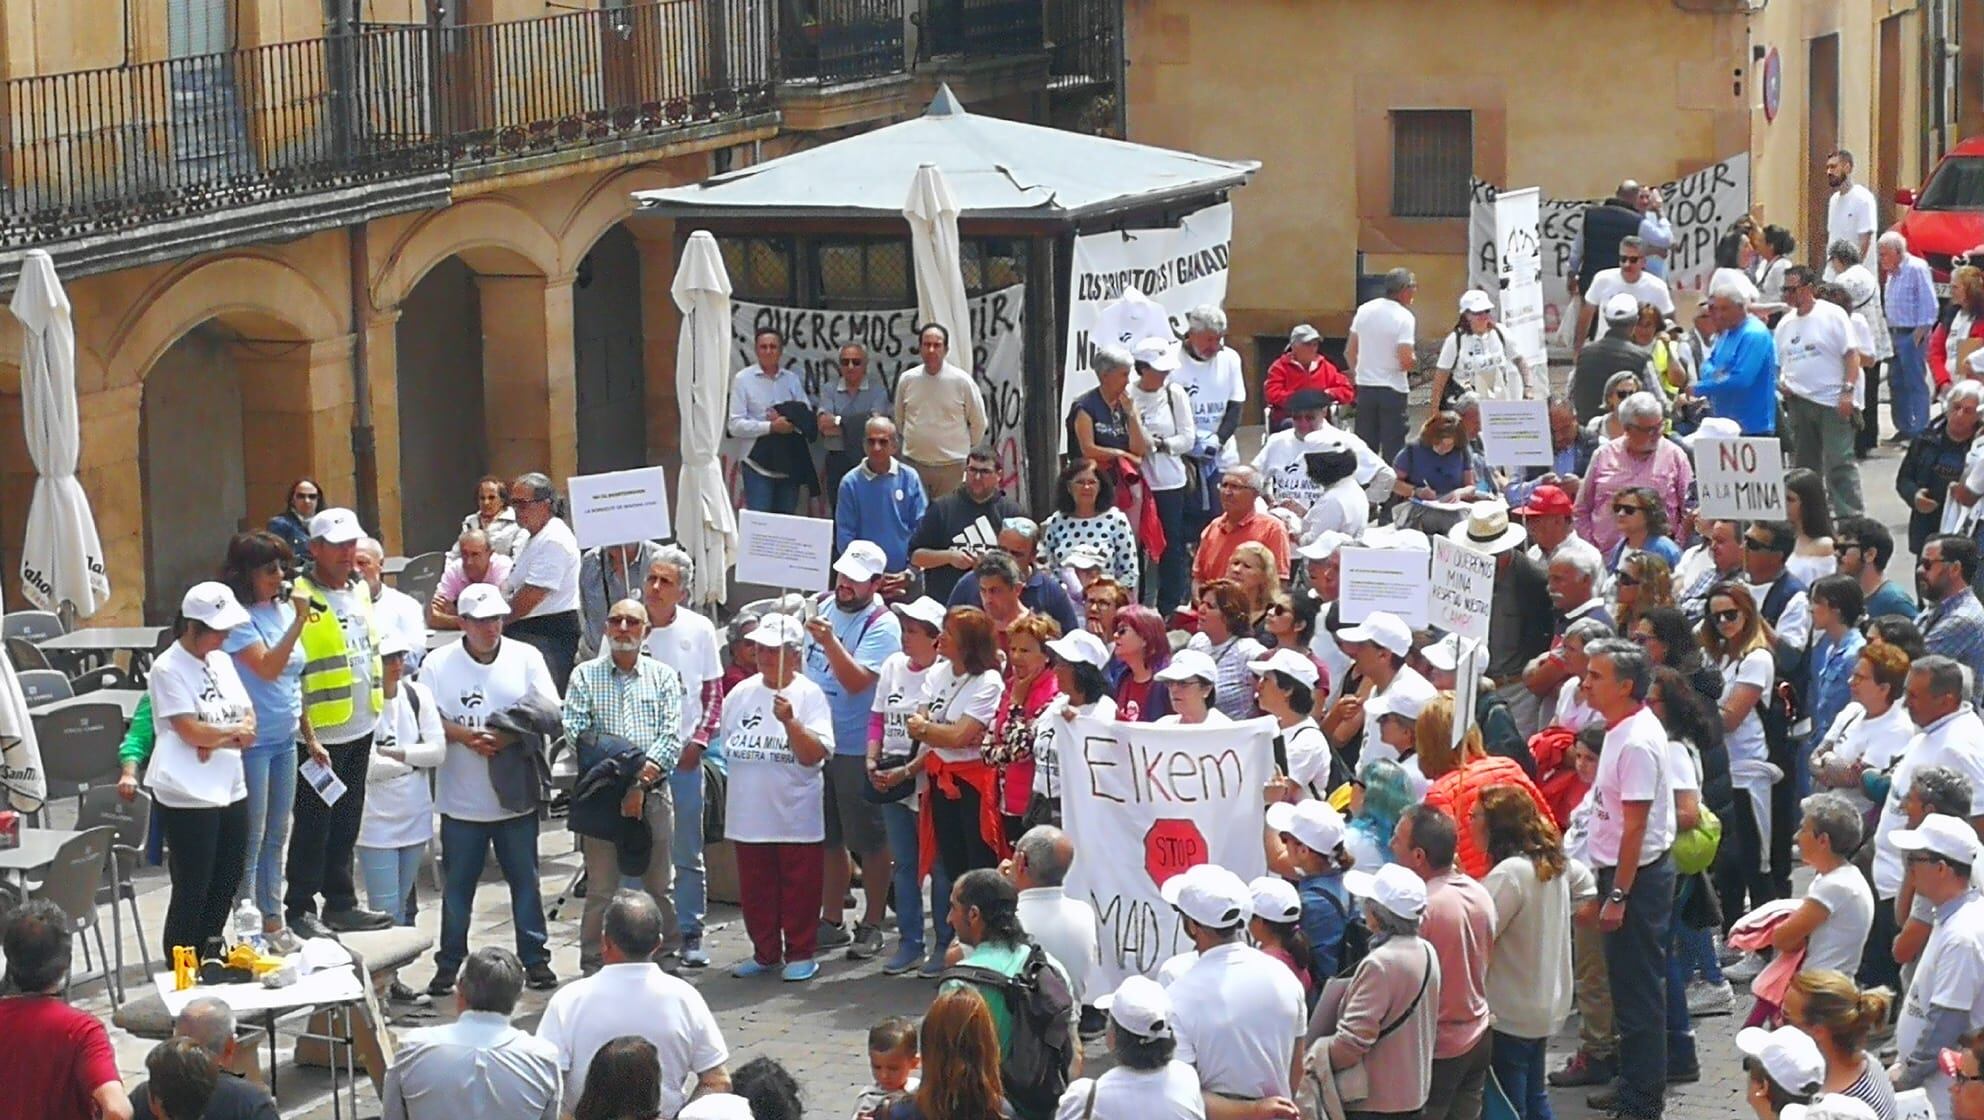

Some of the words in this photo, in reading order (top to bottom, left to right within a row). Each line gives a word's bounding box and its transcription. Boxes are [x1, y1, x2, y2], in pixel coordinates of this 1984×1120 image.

[1177, 241, 1232, 285] GANAD
[754, 308, 902, 357] QUEREMOS
[1719, 442, 1756, 474] NO
[1702, 483, 1711, 500] A
[1716, 483, 1730, 499] LA
[1735, 482, 1782, 511] MINA
[1446, 569, 1472, 594] MINA
[1, 764, 37, 781] SanM
[1083, 735, 1243, 804] Elkem
[1155, 836, 1197, 868] STOP
